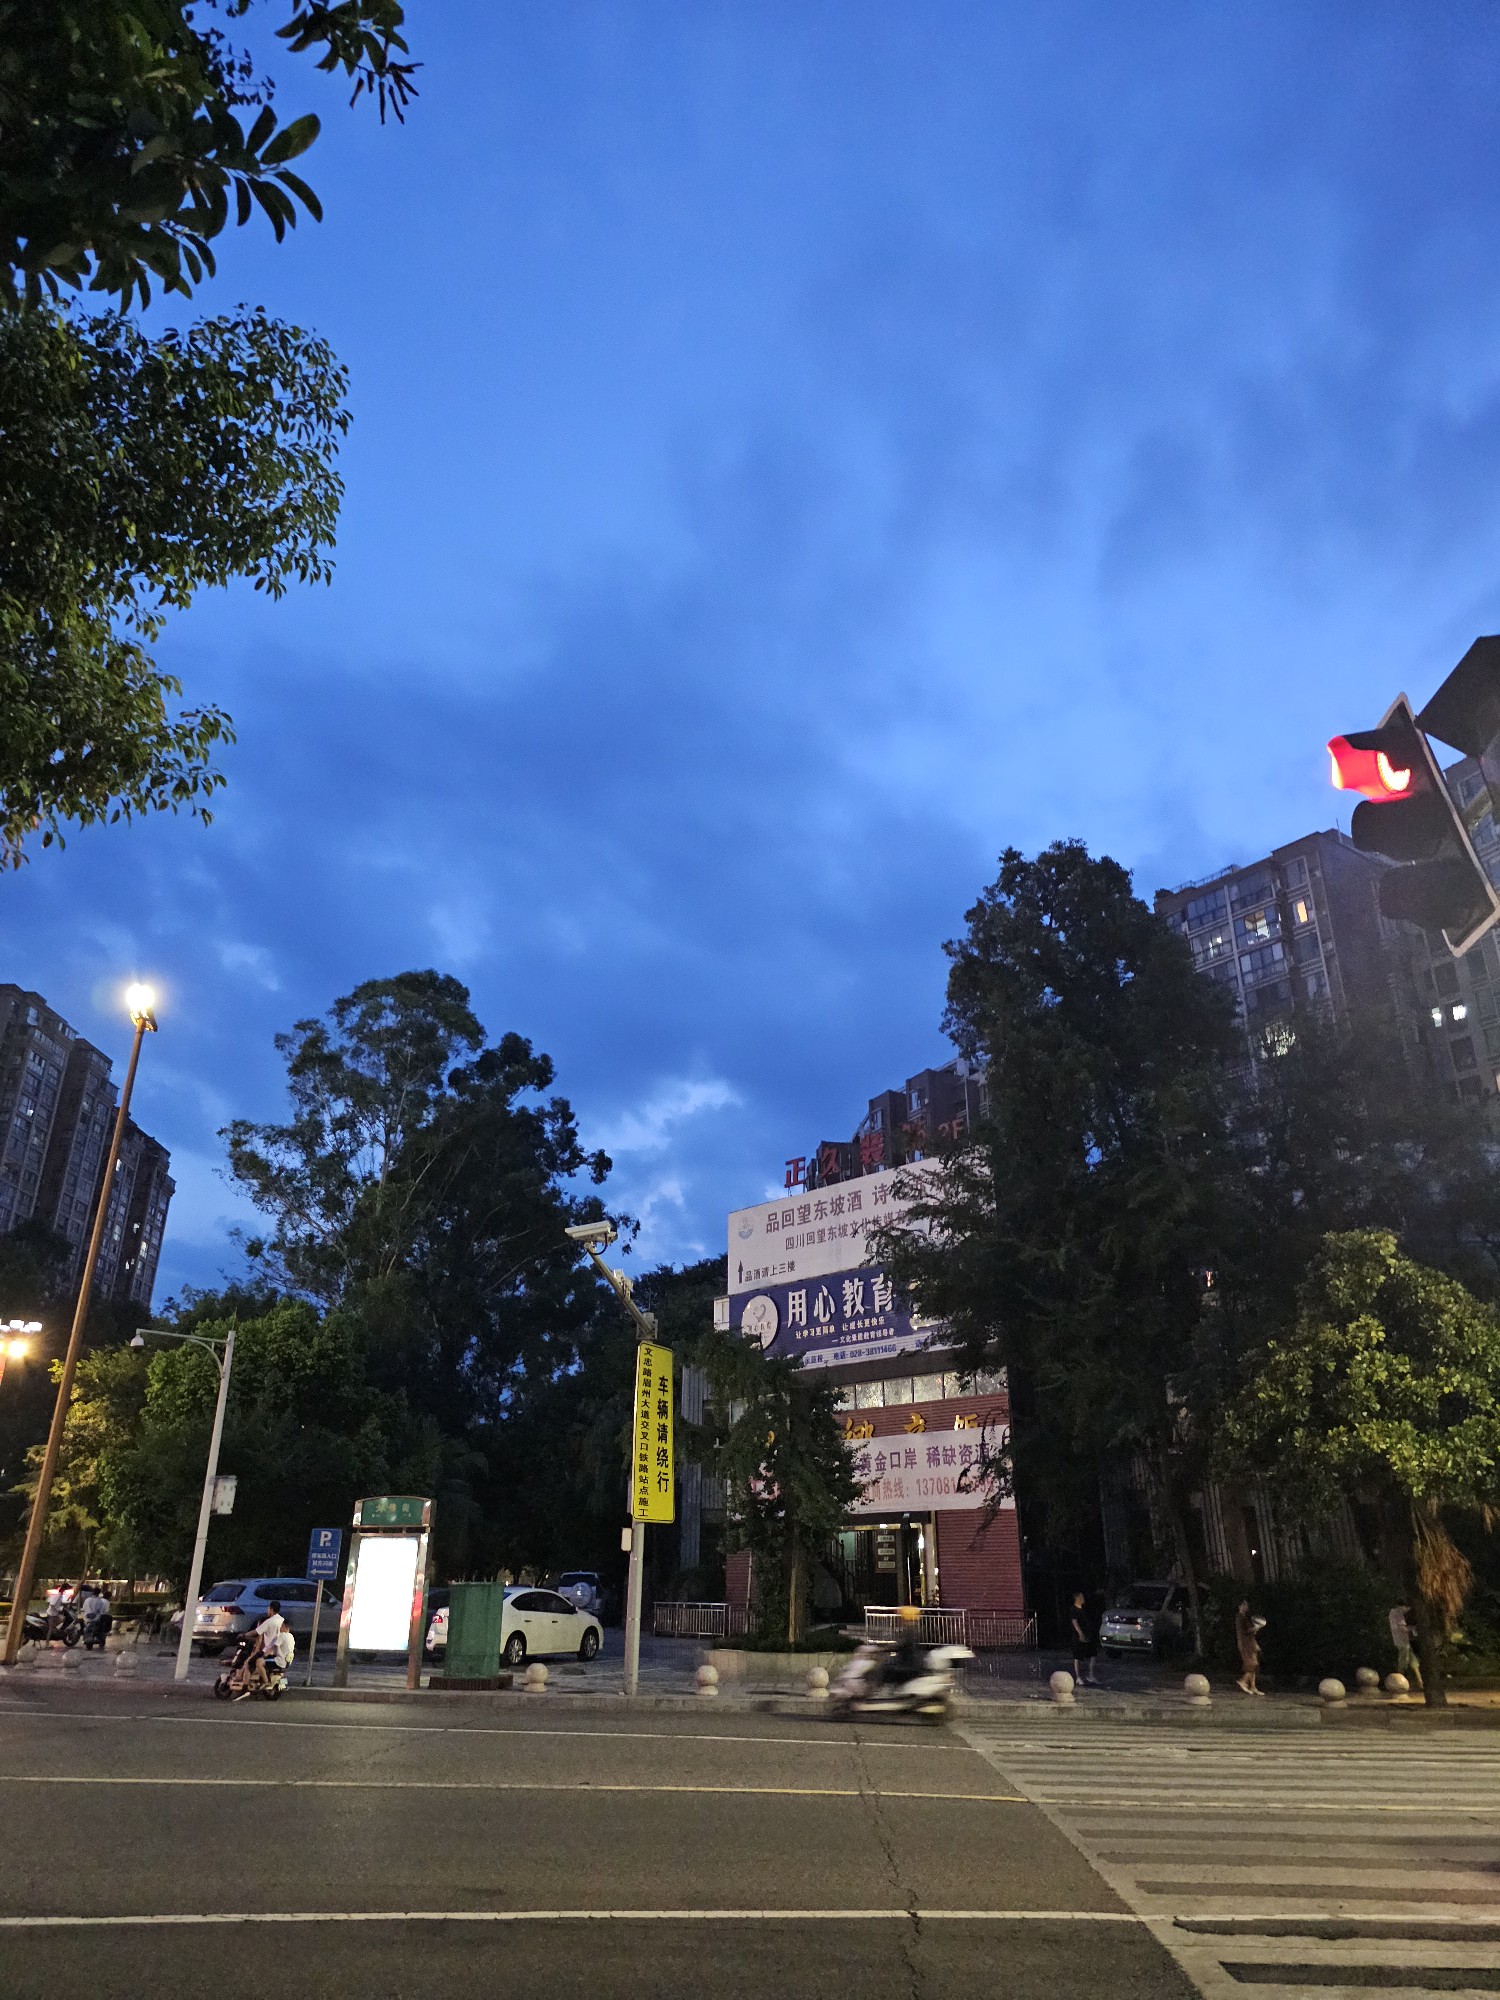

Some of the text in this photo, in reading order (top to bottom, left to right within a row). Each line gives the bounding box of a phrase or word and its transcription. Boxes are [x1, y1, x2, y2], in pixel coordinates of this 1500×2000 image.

[765, 1190, 863, 1234] 品回望东坡酒
[744, 1261, 796, 1282] 品酒请上三楼
[787, 1273, 895, 1329] 用心教育
[656, 1375, 670, 1494] 车辆请绕行
[859, 1442, 990, 1474] 黄金口岸 稀缺资源
[320, 1531, 332, 1547] P
